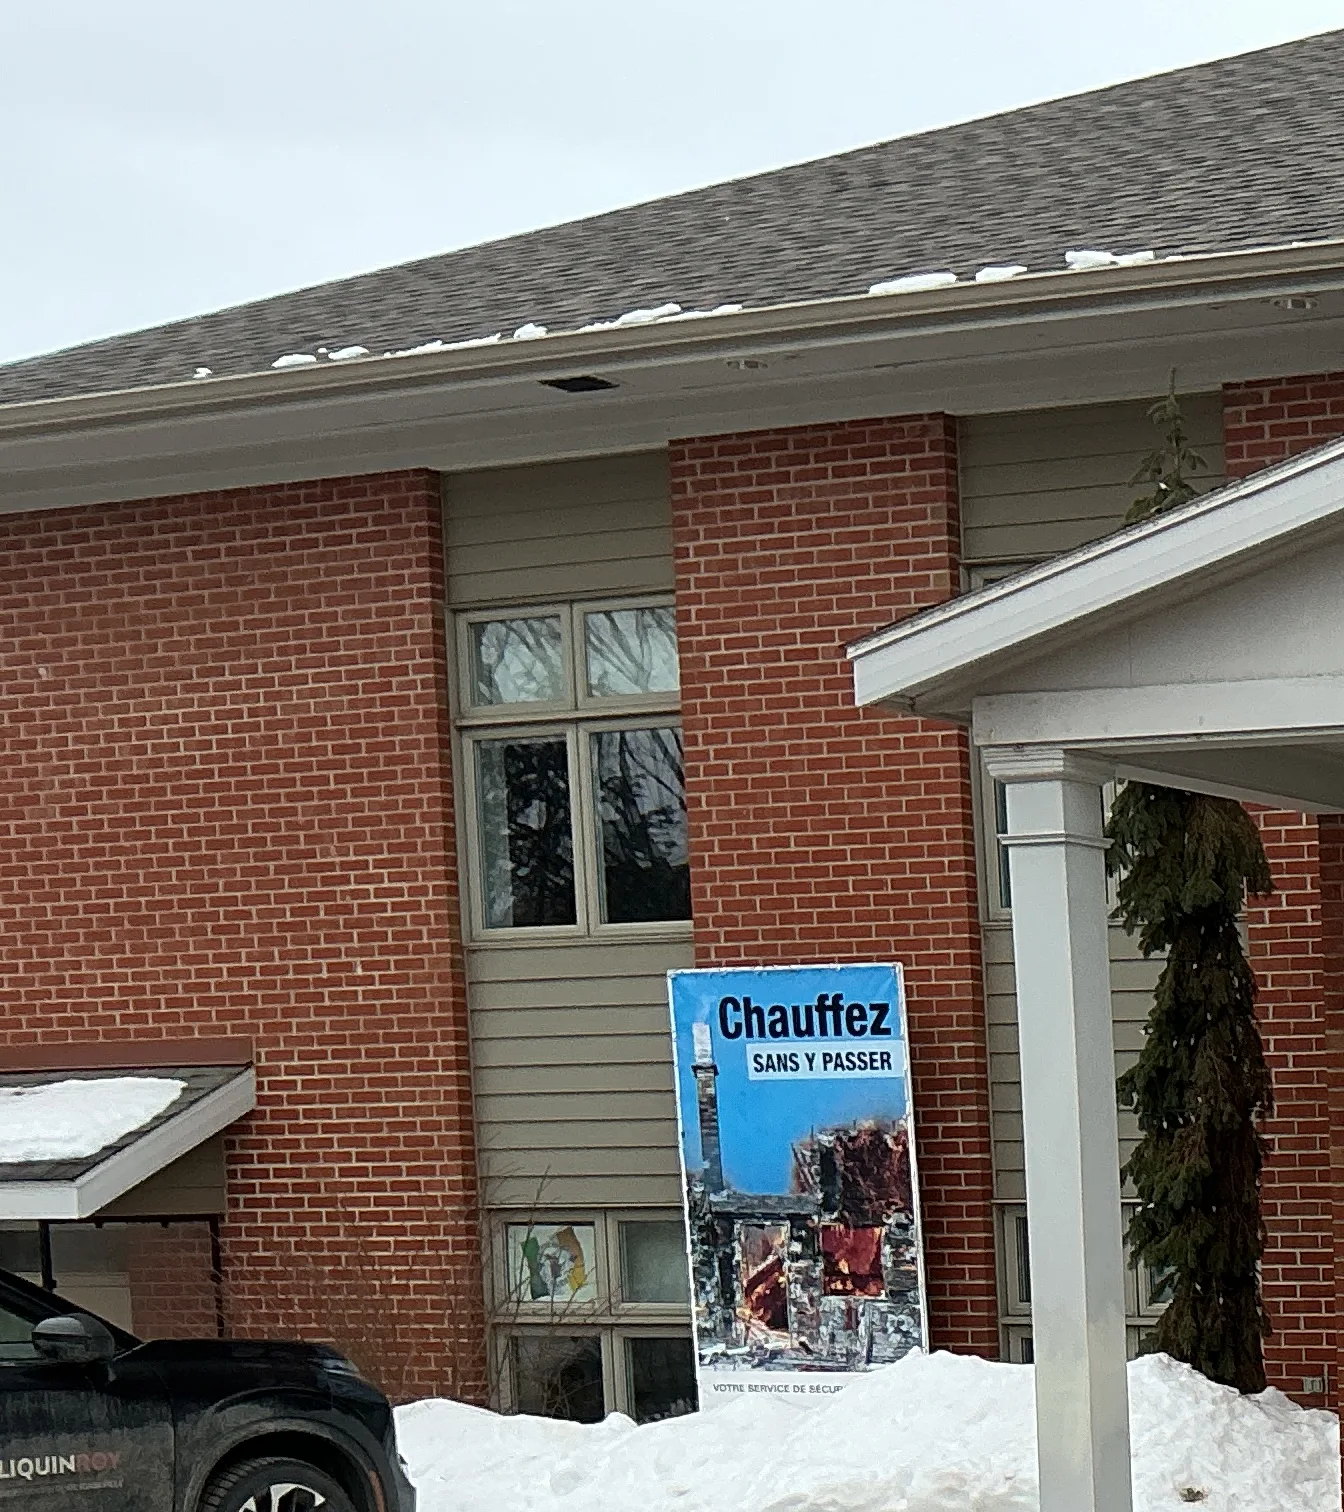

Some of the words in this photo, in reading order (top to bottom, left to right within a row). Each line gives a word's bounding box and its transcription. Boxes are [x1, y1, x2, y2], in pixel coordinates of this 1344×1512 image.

[718, 992, 892, 1040] Chauffez
[753, 1052, 800, 1073] SANS
[804, 1052, 816, 1072] Y
[822, 1051, 892, 1072] PASSER
[713, 1383, 745, 1393] VOTRE
[748, 1384, 789, 1393] SERVICE
[793, 1384, 807, 1394] DE
[809, 1383, 845, 1394] SÉCUR
